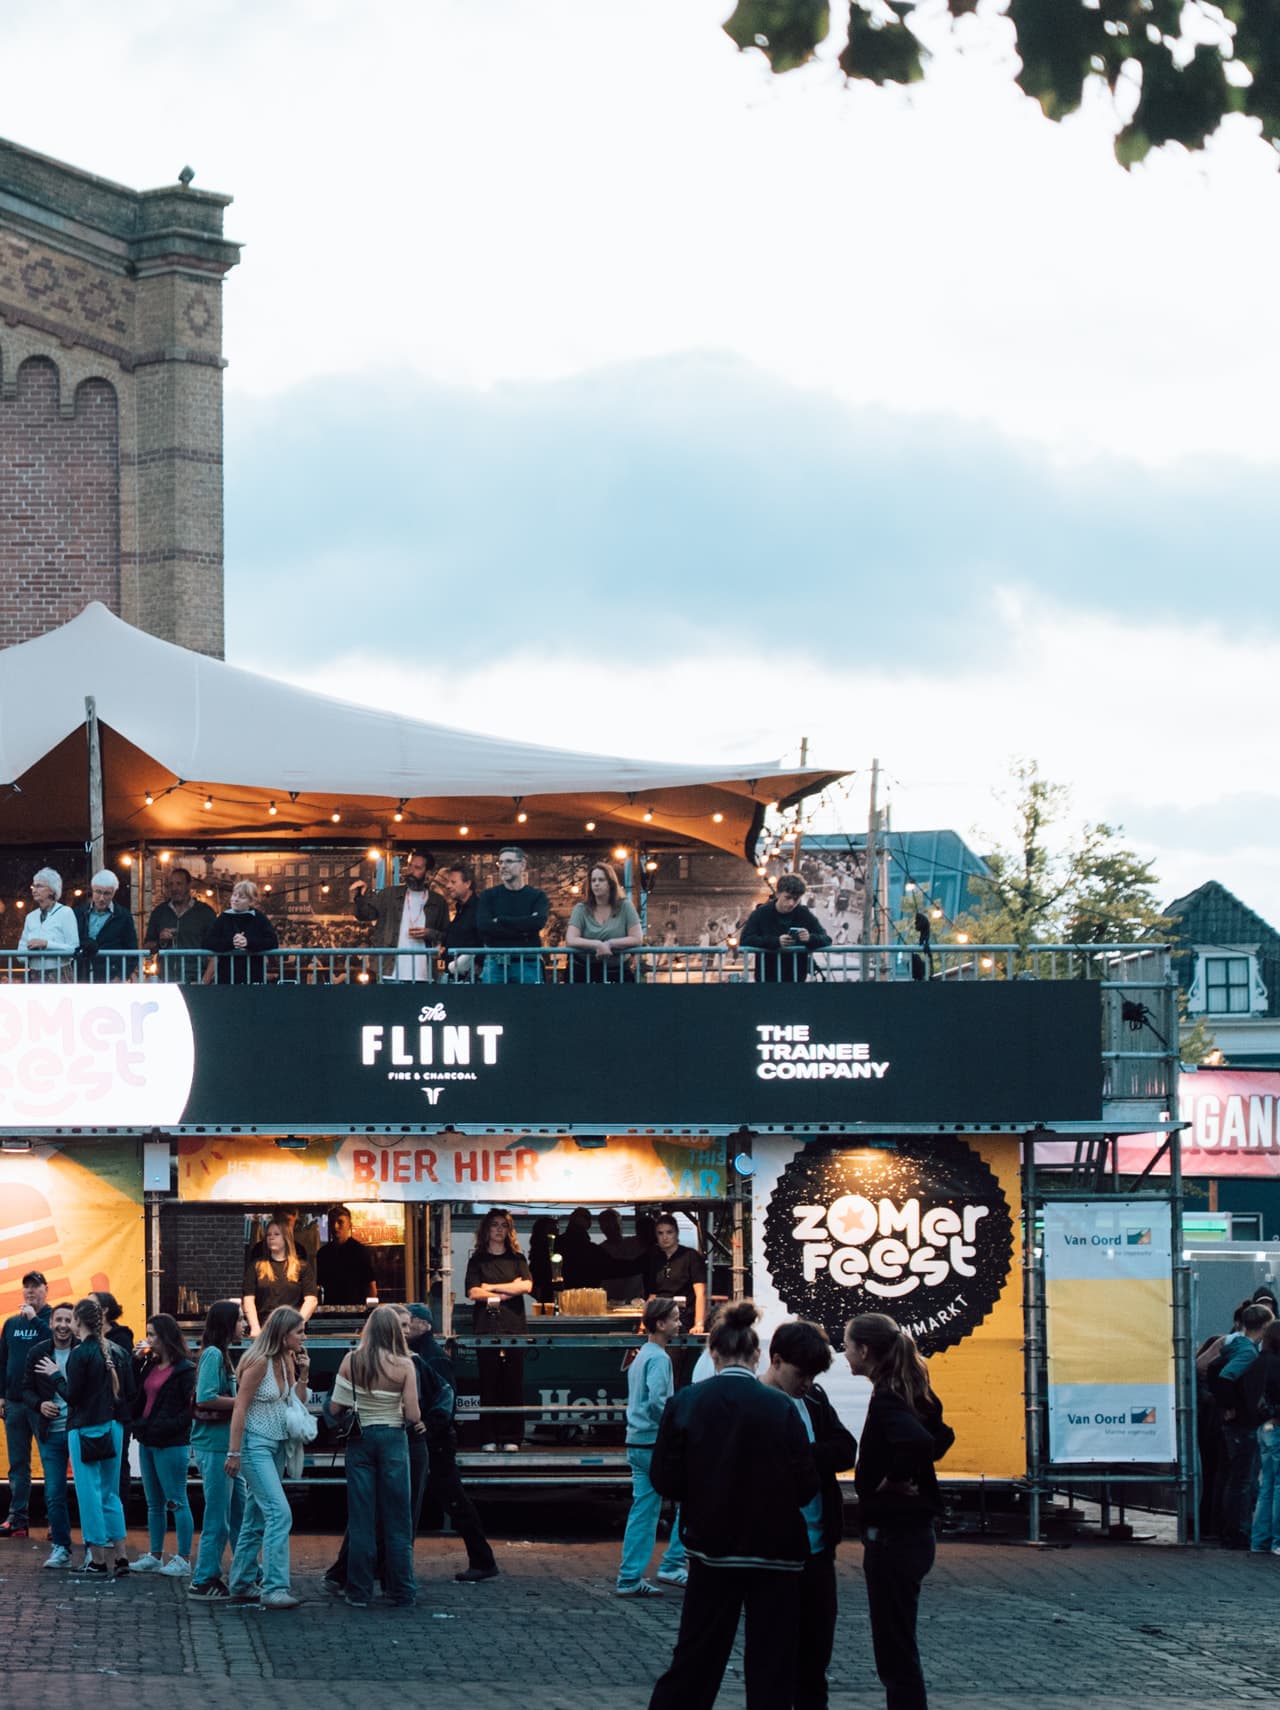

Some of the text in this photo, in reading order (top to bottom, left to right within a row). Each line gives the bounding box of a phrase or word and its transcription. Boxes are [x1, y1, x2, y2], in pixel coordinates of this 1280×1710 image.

[418, 1002, 447, 1022] The
[756, 1025, 810, 1042] THE
[362, 1025, 503, 1065] FLINT
[756, 1044, 870, 1060] TRAINEE
[387, 1072, 411, 1080] FIRE
[423, 1072, 477, 1080] CHARCOAL
[756, 1062, 890, 1079] COMPANY
[1156, 1094, 1280, 1148] NGAN
[353, 1149, 439, 1183] BIER
[454, 1148, 539, 1183] HIER
[655, 1167, 720, 1199] BAR
[1064, 1234, 1121, 1246] Van Oord
[901, 1294, 968, 1339] NMARKT
[1068, 1413, 1126, 1424] Van Oord
